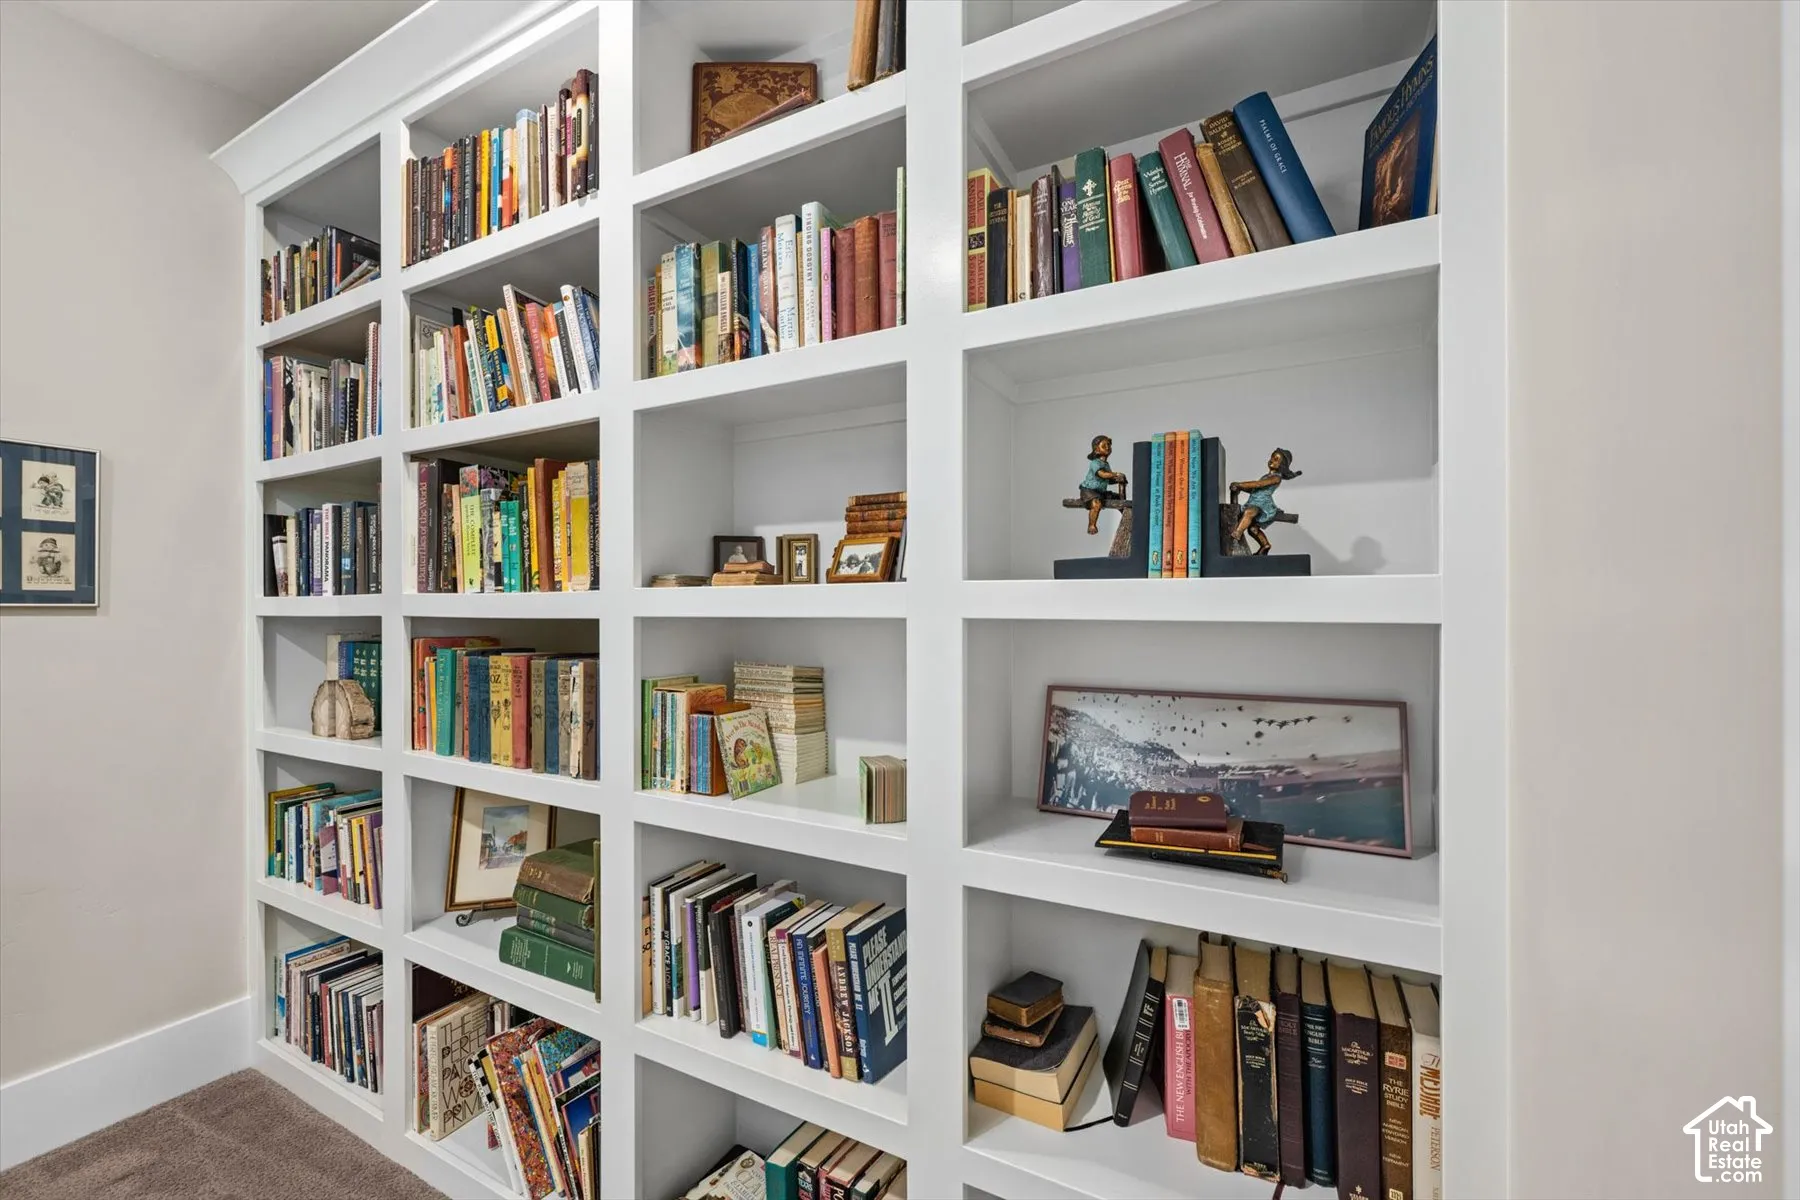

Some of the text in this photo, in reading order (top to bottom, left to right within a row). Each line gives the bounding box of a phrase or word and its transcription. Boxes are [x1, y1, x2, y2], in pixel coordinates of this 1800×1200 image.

[1259, 119, 1274, 143] PSALMS
[1274, 153, 1288, 174] GRACE
[1173, 151, 1193, 191] HYMNAL
[977, 189, 985, 211] CARL
[493, 350, 503, 385] GERMANY
[532, 327, 548, 390] BOYS BOAT
[663, 939, 671, 964] GRACE
[769, 936, 777, 958] REAL
[849, 941, 857, 960] PLEASE
[863, 925, 888, 969] PLEASE
[797, 953, 807, 981] INFINITE
[801, 982, 812, 1016] JOURNEY
[838, 965, 854, 1054] ANDREW JACKSON
[868, 984, 881, 1015] ME
[879, 971, 899, 1047] II
[440, 1012, 472, 1047] THE
[1175, 1042, 1184, 1080] ENGLISH
[1175, 1080, 1184, 1103] NEW
[1382, 1083, 1410, 1098] RYRIE
[1384, 1092, 1409, 1104] STUDY
[1388, 1077, 1405, 1086] THE
[1175, 1104, 1185, 1122] THE
[1430, 1126, 1441, 1172] PETERSON
